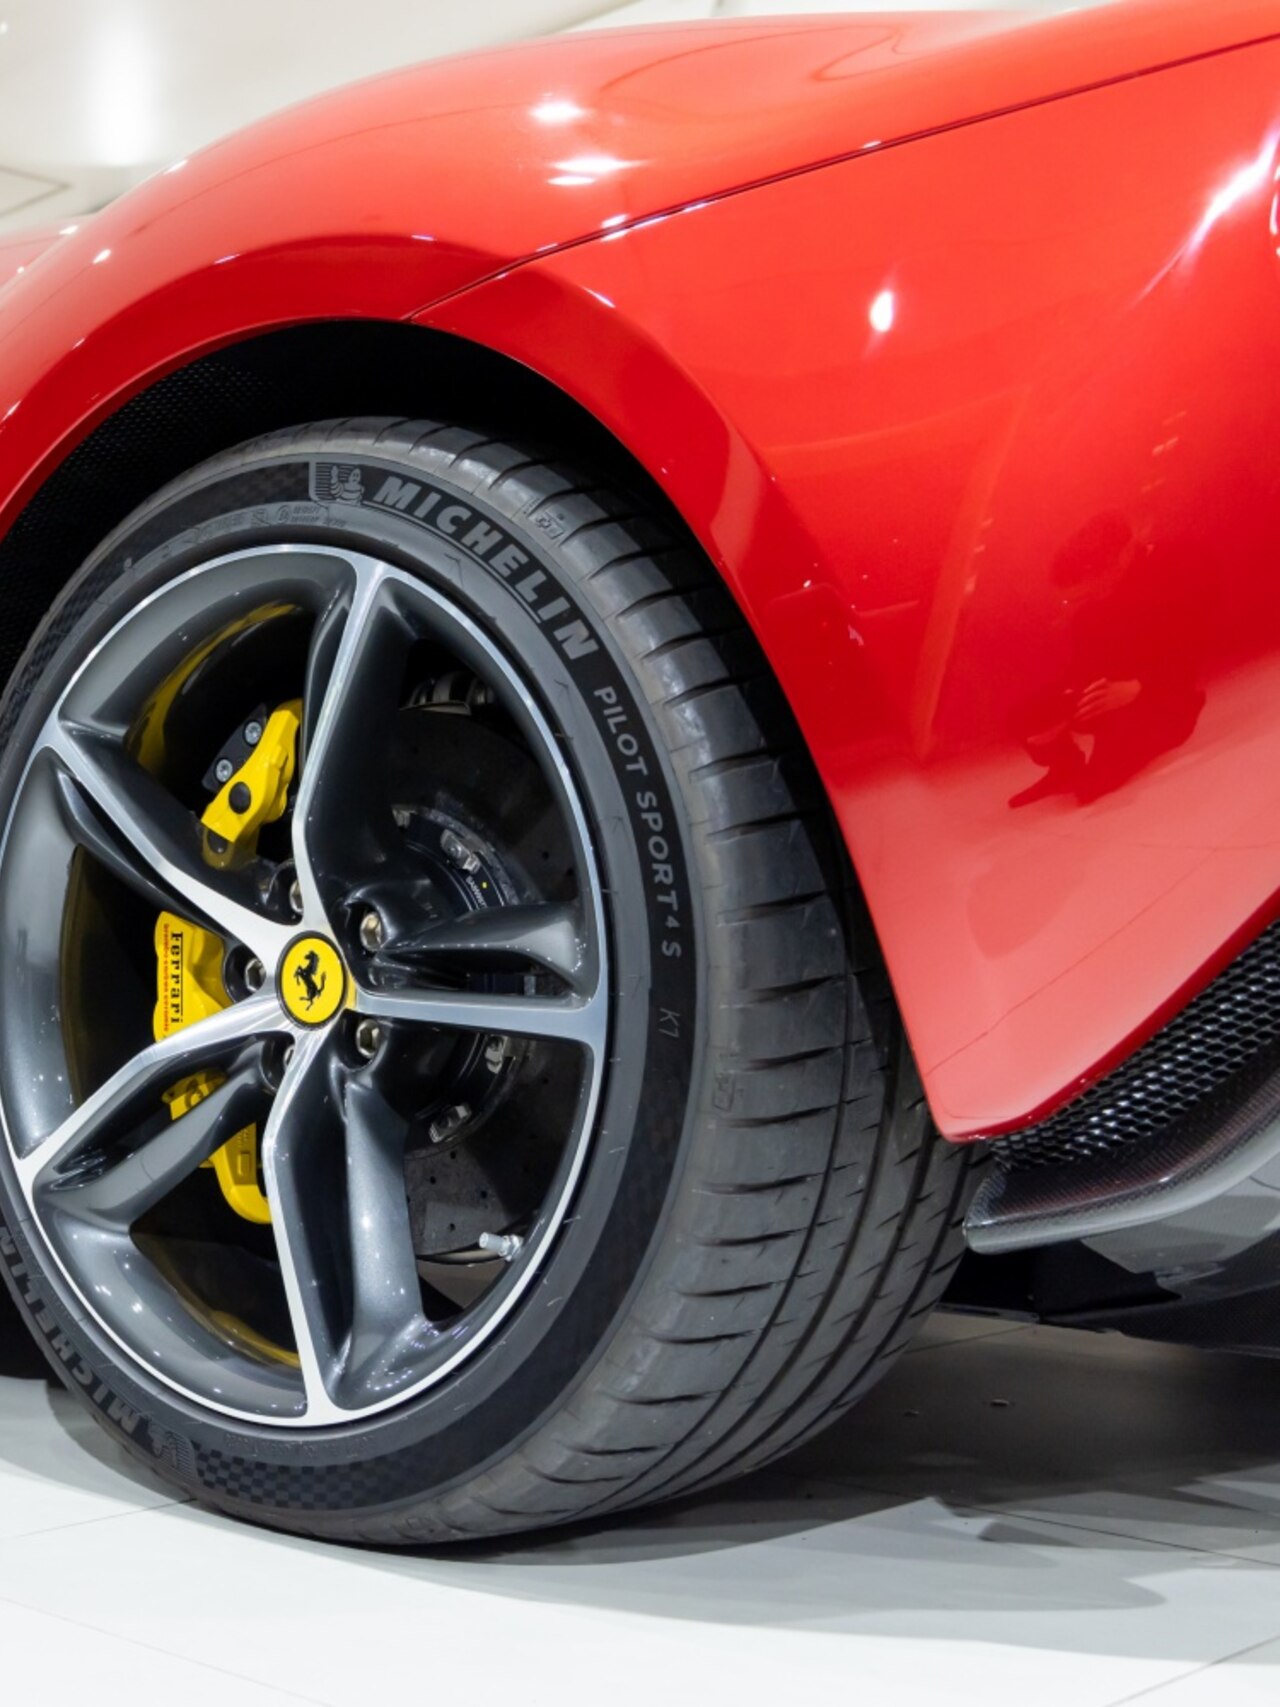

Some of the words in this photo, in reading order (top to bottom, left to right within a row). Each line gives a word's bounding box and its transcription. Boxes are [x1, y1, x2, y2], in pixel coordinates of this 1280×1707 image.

[373, 476, 599, 660] MICHELIN
[594, 685, 648, 776] PILOT
[636, 791, 678, 911] SPORT
[662, 940, 682, 958] S
[171, 931, 183, 1023] Ferrari
